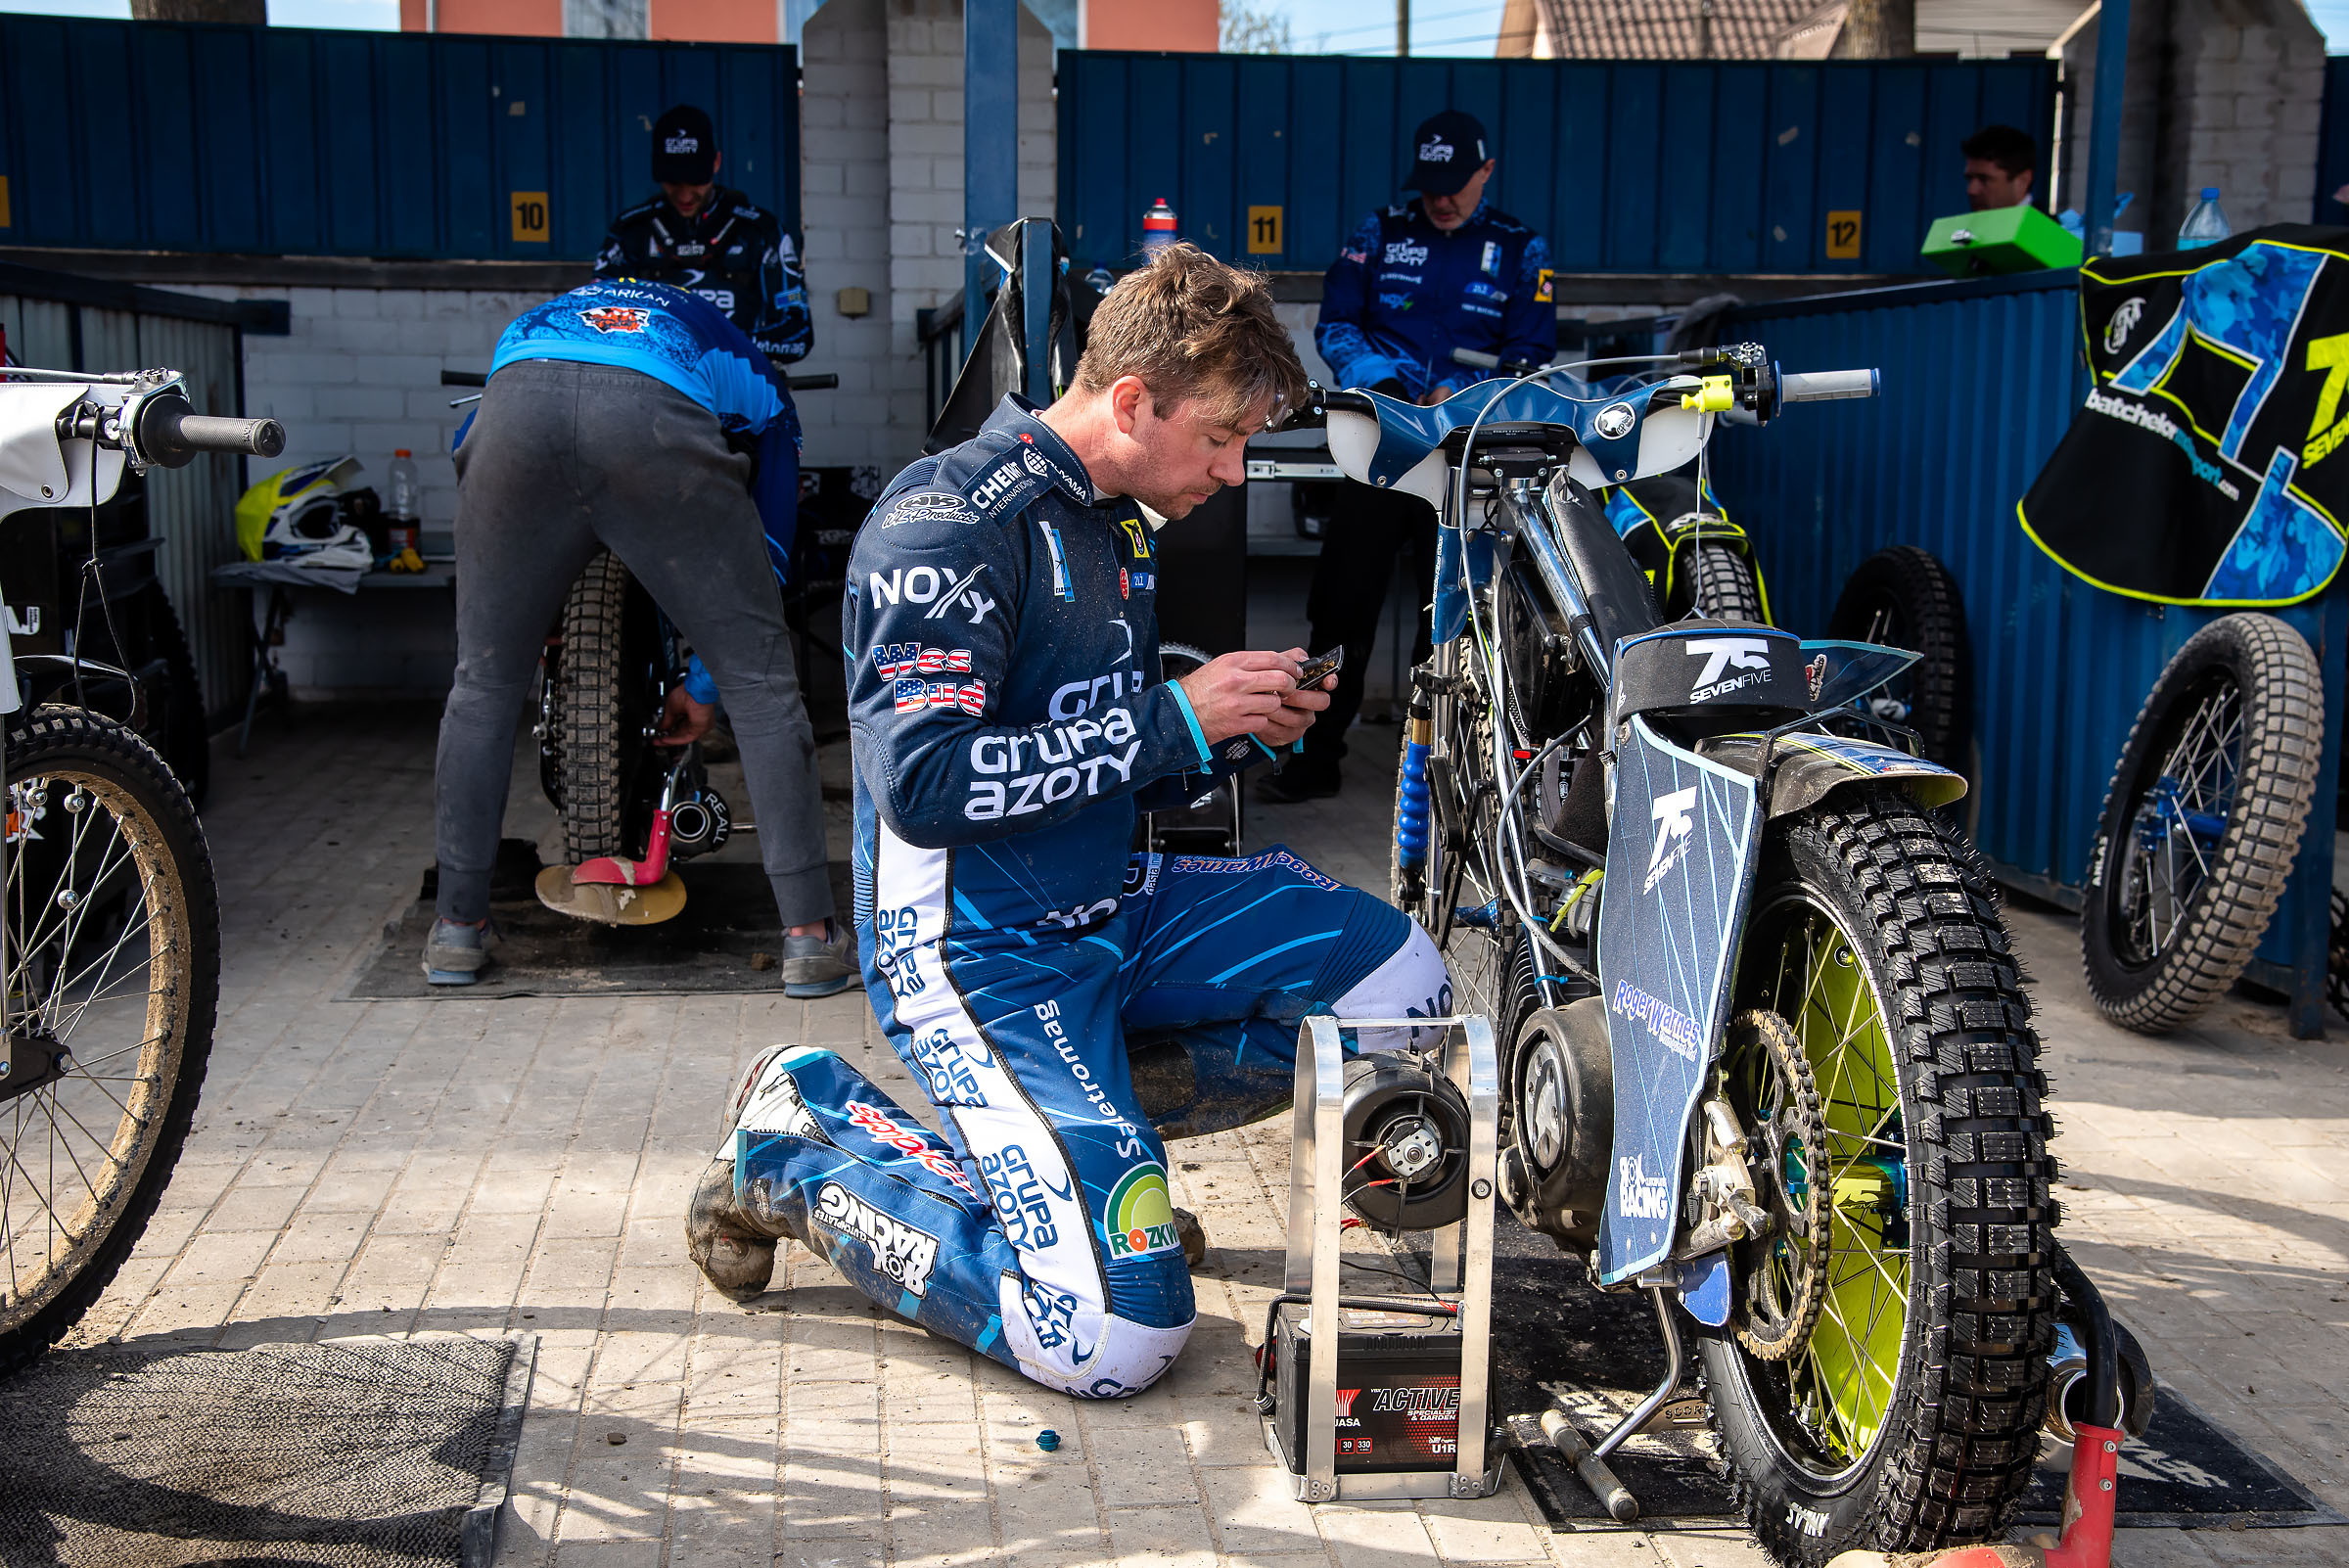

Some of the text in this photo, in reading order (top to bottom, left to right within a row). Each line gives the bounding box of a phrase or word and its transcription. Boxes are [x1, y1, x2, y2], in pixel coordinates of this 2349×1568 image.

[517, 202, 544, 230] 10
[1253, 216, 1275, 243] 11
[1831, 221, 1856, 247] 12
[872, 642, 972, 682] Wes
[1685, 637, 1771, 690] 75
[894, 677, 987, 716] Bud
[1689, 669, 1773, 705] SEVENFIVE
[1620, 1185, 1669, 1220] RACING
[820, 1183, 937, 1264] RACING
[1372, 1387, 1461, 1411] ACTIVE
[1358, 1440, 1371, 1449] 330
[1432, 1444, 1456, 1453] U1R
